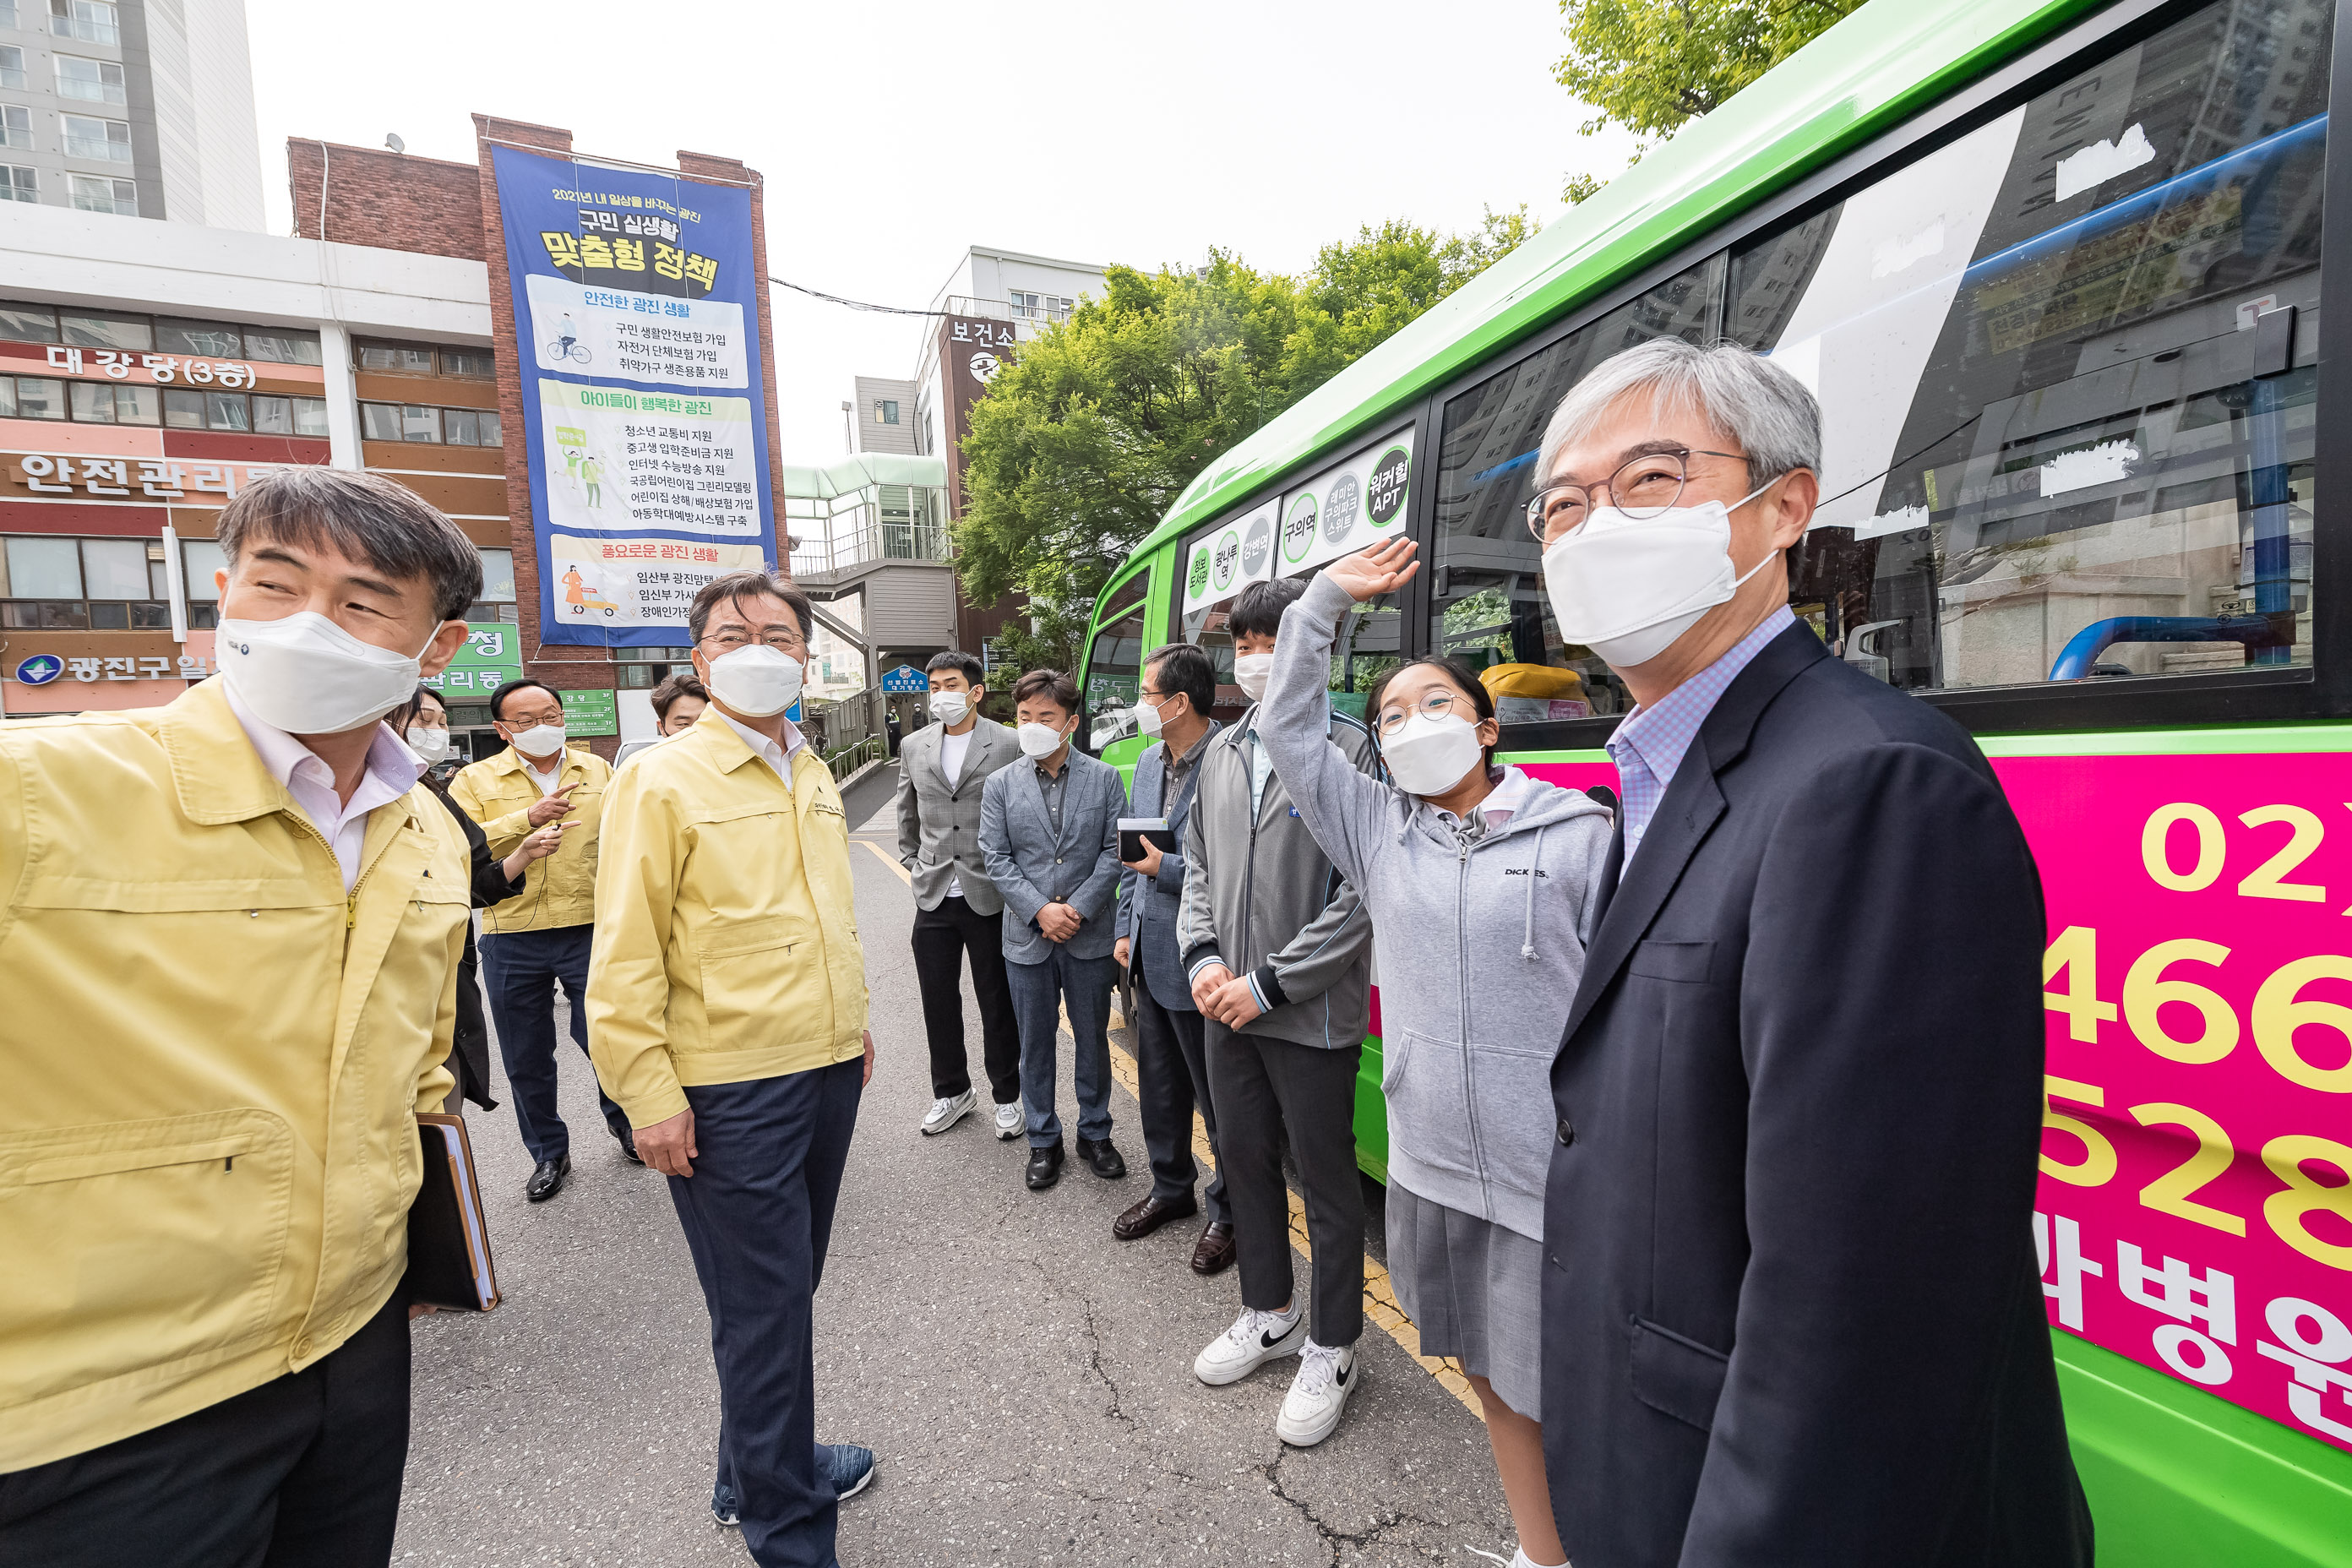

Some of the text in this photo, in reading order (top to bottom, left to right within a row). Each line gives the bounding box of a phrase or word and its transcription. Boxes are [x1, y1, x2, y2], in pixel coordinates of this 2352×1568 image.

[553, 188, 702, 224] 2021년 내 일상을 바꾸는 광진
[580, 210, 680, 242] 구민 실생활
[541, 231, 719, 291] 맞춤형 정책
[584, 291, 691, 318] 안전한 광진 생활
[616, 322, 726, 346] 구민 생활안전보험 가입
[950, 321, 1015, 349] 보건소
[618, 340, 717, 362] 자전거 단체보험 가입
[619, 357, 729, 379] 취약가구 생존용품 지원
[580, 389, 712, 416] 아이들이 행복한 광진
[625, 425, 712, 443] 청소년 교통비 지원
[626, 442, 734, 460] 중고생 입학준비금 지원
[20, 455, 279, 500] 안전관리
[629, 459, 725, 476] 인터넷 수능방송 지원
[1369, 460, 1409, 496] 워커힐
[630, 476, 752, 493] 국공립어린이집 그린리모델링
[1330, 480, 1356, 504] 래미안
[631, 492, 669, 504] 어린이집
[735, 499, 754, 510] 가입
[1325, 494, 1358, 522] 구의파크
[1371, 486, 1400, 516] APT
[633, 508, 748, 527] 아동학대예방시스템 구축
[1284, 510, 1317, 542] 구의역
[1326, 516, 1353, 536] 스위트
[602, 544, 719, 563] 풍요로운 광진 생활
[1215, 543, 1238, 568] 광나루
[1243, 532, 1270, 561] 강변역
[1194, 555, 1207, 574] 정보
[1221, 564, 1229, 580] 역
[637, 571, 724, 585] 임산부 광진맘택
[1189, 572, 1208, 589] 도서관
[639, 589, 672, 602] 임신부
[461, 629, 504, 657] 청
[68, 655, 172, 682] 광진구
[1505, 868, 1546, 878] DICKES
